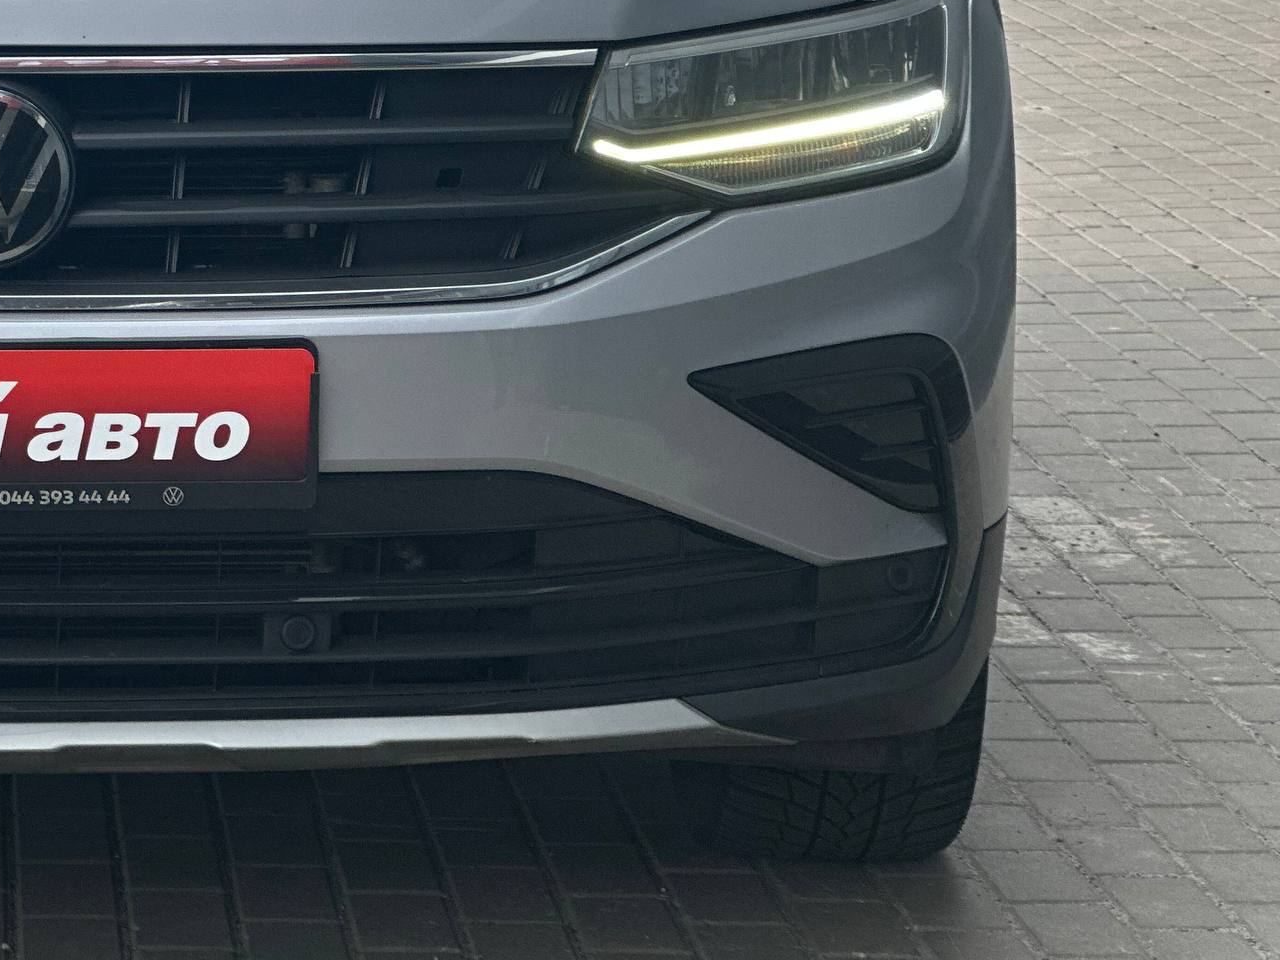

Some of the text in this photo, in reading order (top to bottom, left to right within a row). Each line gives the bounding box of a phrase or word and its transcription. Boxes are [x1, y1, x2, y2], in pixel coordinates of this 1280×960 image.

[27, 411, 250, 462] авто
[0, 490, 34, 505] 044
[39, 490, 73, 505] 393
[79, 489, 102, 504] 44
[106, 489, 130, 504] 44
